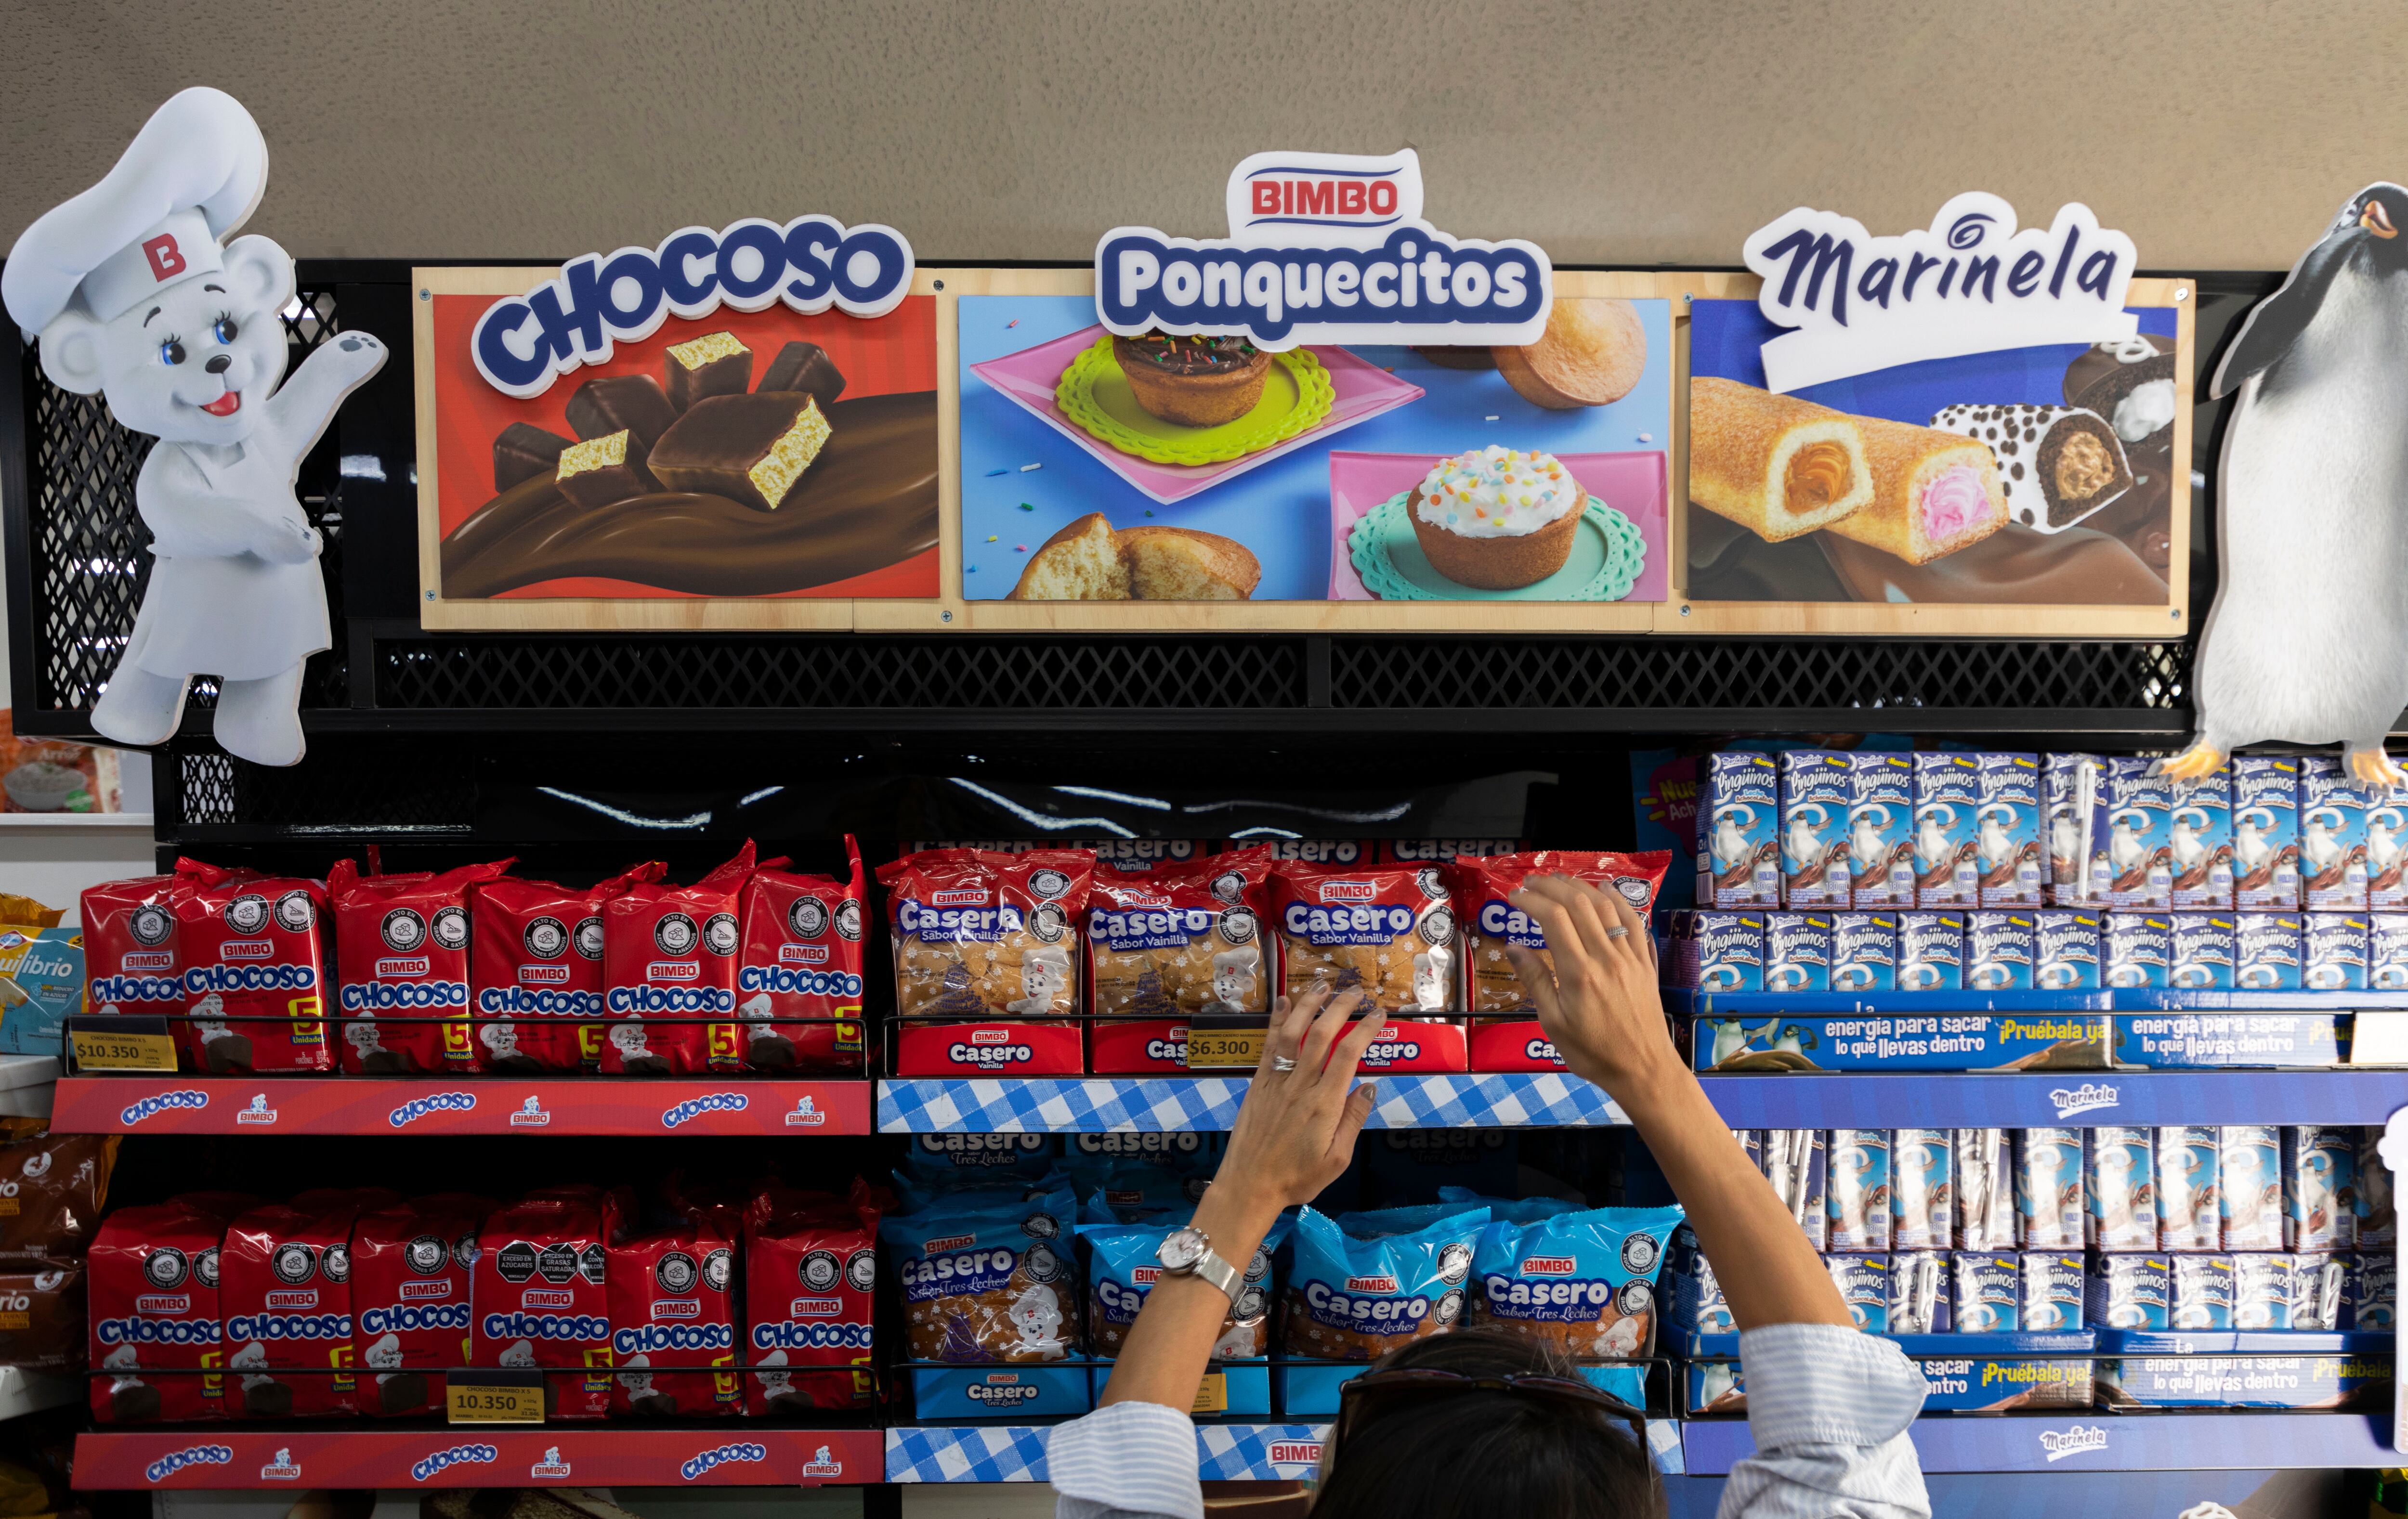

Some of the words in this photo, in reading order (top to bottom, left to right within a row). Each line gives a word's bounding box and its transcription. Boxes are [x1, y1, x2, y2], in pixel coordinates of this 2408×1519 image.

[1252, 181, 1397, 215] BIMBO
[142, 233, 186, 282] B
[1762, 213, 2117, 327] Marinela
[1120, 241, 1527, 322] Ponquecitos
[479, 221, 904, 385] CHOCOSO
[1114, 862, 1151, 870] Vainilla
[1323, 887, 1373, 897] BIMBO
[1754, 883, 1765, 891] 180
[937, 893, 985, 903] BIMBO
[900, 902, 1020, 932] Casero
[1089, 910, 1207, 937] Casero
[1287, 906, 1411, 932] Casero
[923, 931, 953, 941] Sabor
[1112, 939, 1143, 949] Sabor
[1146, 936, 1188, 947] Vainilla
[1313, 934, 1346, 944] Sabor
[1349, 934, 1391, 943] Vainilla
[224, 944, 270, 956] BIMBO
[783, 948, 826, 960] BIMBO
[126, 955, 170, 966] BIMBO
[380, 962, 426, 973] BIMBO
[186, 965, 315, 992] CHOCOSO
[522, 969, 566, 979] BIMBO
[651, 966, 696, 976] BIMBO
[92, 977, 184, 1001] CHOCOS
[740, 967, 862, 996] CHOCOSO
[342, 983, 469, 1008] CHOCOSO
[482, 987, 604, 1014] CHOCOSO
[609, 986, 734, 1011] CHOCOSO
[297, 1002, 320, 1033] 5
[975, 1032, 1006, 1040] BIMBO
[1825, 1018, 1891, 1041] energía
[1896, 1017, 1937, 1039] para
[1941, 1016, 1991, 1032] sacar
[2000, 1019, 2082, 1044] ¡Pruébala
[77, 1043, 139, 1058] $10.350
[951, 1046, 1030, 1061] Casero
[1190, 1040, 1249, 1056] $6.300
[1835, 1040, 1848, 1055] lo
[1851, 1041, 1876, 1059] que
[1878, 1039, 1927, 1058] llevas
[1930, 1035, 1985, 1052] dentro
[2053, 1087, 2114, 1107] Marinela
[123, 1092, 207, 1123] CHOCOSO
[241, 1113, 274, 1122] BIMBO
[391, 1093, 474, 1126] CHOCOSO
[664, 1094, 747, 1127] CHOCOSO
[513, 1114, 547, 1123] BIMBO
[788, 1114, 822, 1123] BIMBO
[952, 1155, 978, 1165] Tres
[980, 1153, 1015, 1166] Leches
[926, 1237, 973, 1250] BIMBO
[903, 1251, 1012, 1285] Casero
[1525, 1260, 1573, 1272] BIMBO
[403, 1283, 448, 1296] BIMBO
[940, 1281, 966, 1294] Tres
[967, 1274, 1006, 1291] Leches
[1349, 1278, 1395, 1290] BIMBO
[1486, 1277, 1608, 1304] Casero
[141, 1298, 187, 1309] BIMBO
[270, 1294, 314, 1305] BIMBO
[525, 1293, 570, 1304] BIMBO
[795, 1302, 839, 1313] BIMBO
[1307, 1283, 1426, 1318] Casero
[363, 1303, 470, 1333] CHOCOS
[654, 1303, 697, 1315] BIMBO
[1493, 1307, 1531, 1318] Sabor
[1531, 1308, 1557, 1318] Tres
[1560, 1306, 1597, 1320] Leches
[229, 1315, 352, 1340] CHOCOSO
[485, 1313, 609, 1339] CHOCOSO
[1313, 1311, 1350, 1328] Sabor
[1350, 1318, 1376, 1333] Tres
[1378, 1321, 1414, 1334] Leches
[615, 1324, 733, 1352] CHOCOSO
[755, 1322, 873, 1348] CHOCOSO
[1926, 1360, 1974, 1375] sacar
[1982, 1363, 2061, 1387] ¡Pruébala
[968, 1386, 1036, 1398] Casero
[2154, 1375, 2165, 1389] lo
[2170, 1377, 2192, 1393] que
[2195, 1374, 2242, 1393] llevas
[2245, 1372, 2298, 1389] dentro
[458, 1395, 516, 1410] 10.350
[2042, 1428, 2103, 1450] Marinela
[148, 1446, 231, 1480] CHOCOSO
[414, 1446, 496, 1480] CHOCOSO
[535, 1467, 568, 1475] BIMBO
[682, 1444, 765, 1479] CHOCOSO
[806, 1465, 839, 1474] BIMBO
[265, 1468, 297, 1477] BIMBO
